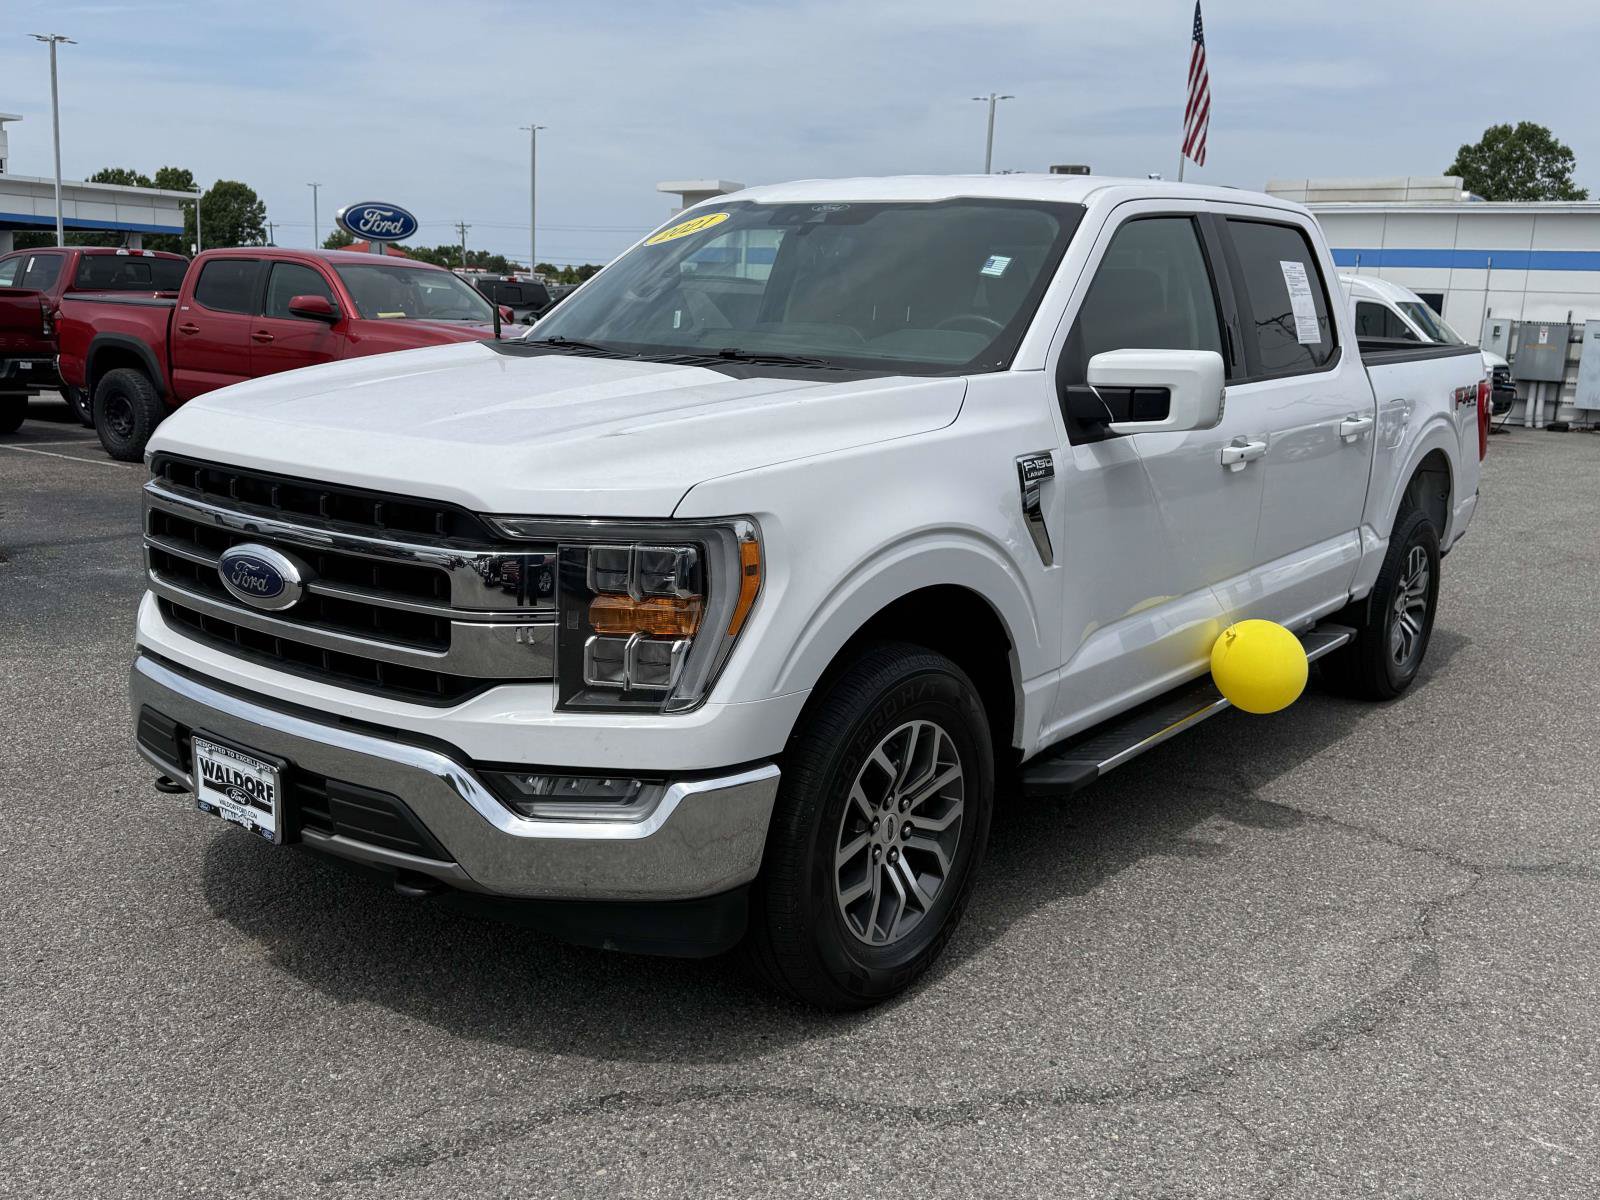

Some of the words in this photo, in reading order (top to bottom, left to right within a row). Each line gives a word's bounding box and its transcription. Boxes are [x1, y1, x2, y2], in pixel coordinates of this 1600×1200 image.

[360, 208, 404, 233] Ford
[1023, 458, 1053, 472] F-150
[231, 560, 269, 592] Ford
[195, 738, 226, 756] DEDICATED
[227, 750, 235, 759] TO
[235, 754, 272, 773] EXCELLENCE
[198, 756, 275, 804] WALDORF
[230, 789, 247, 805] Ford
